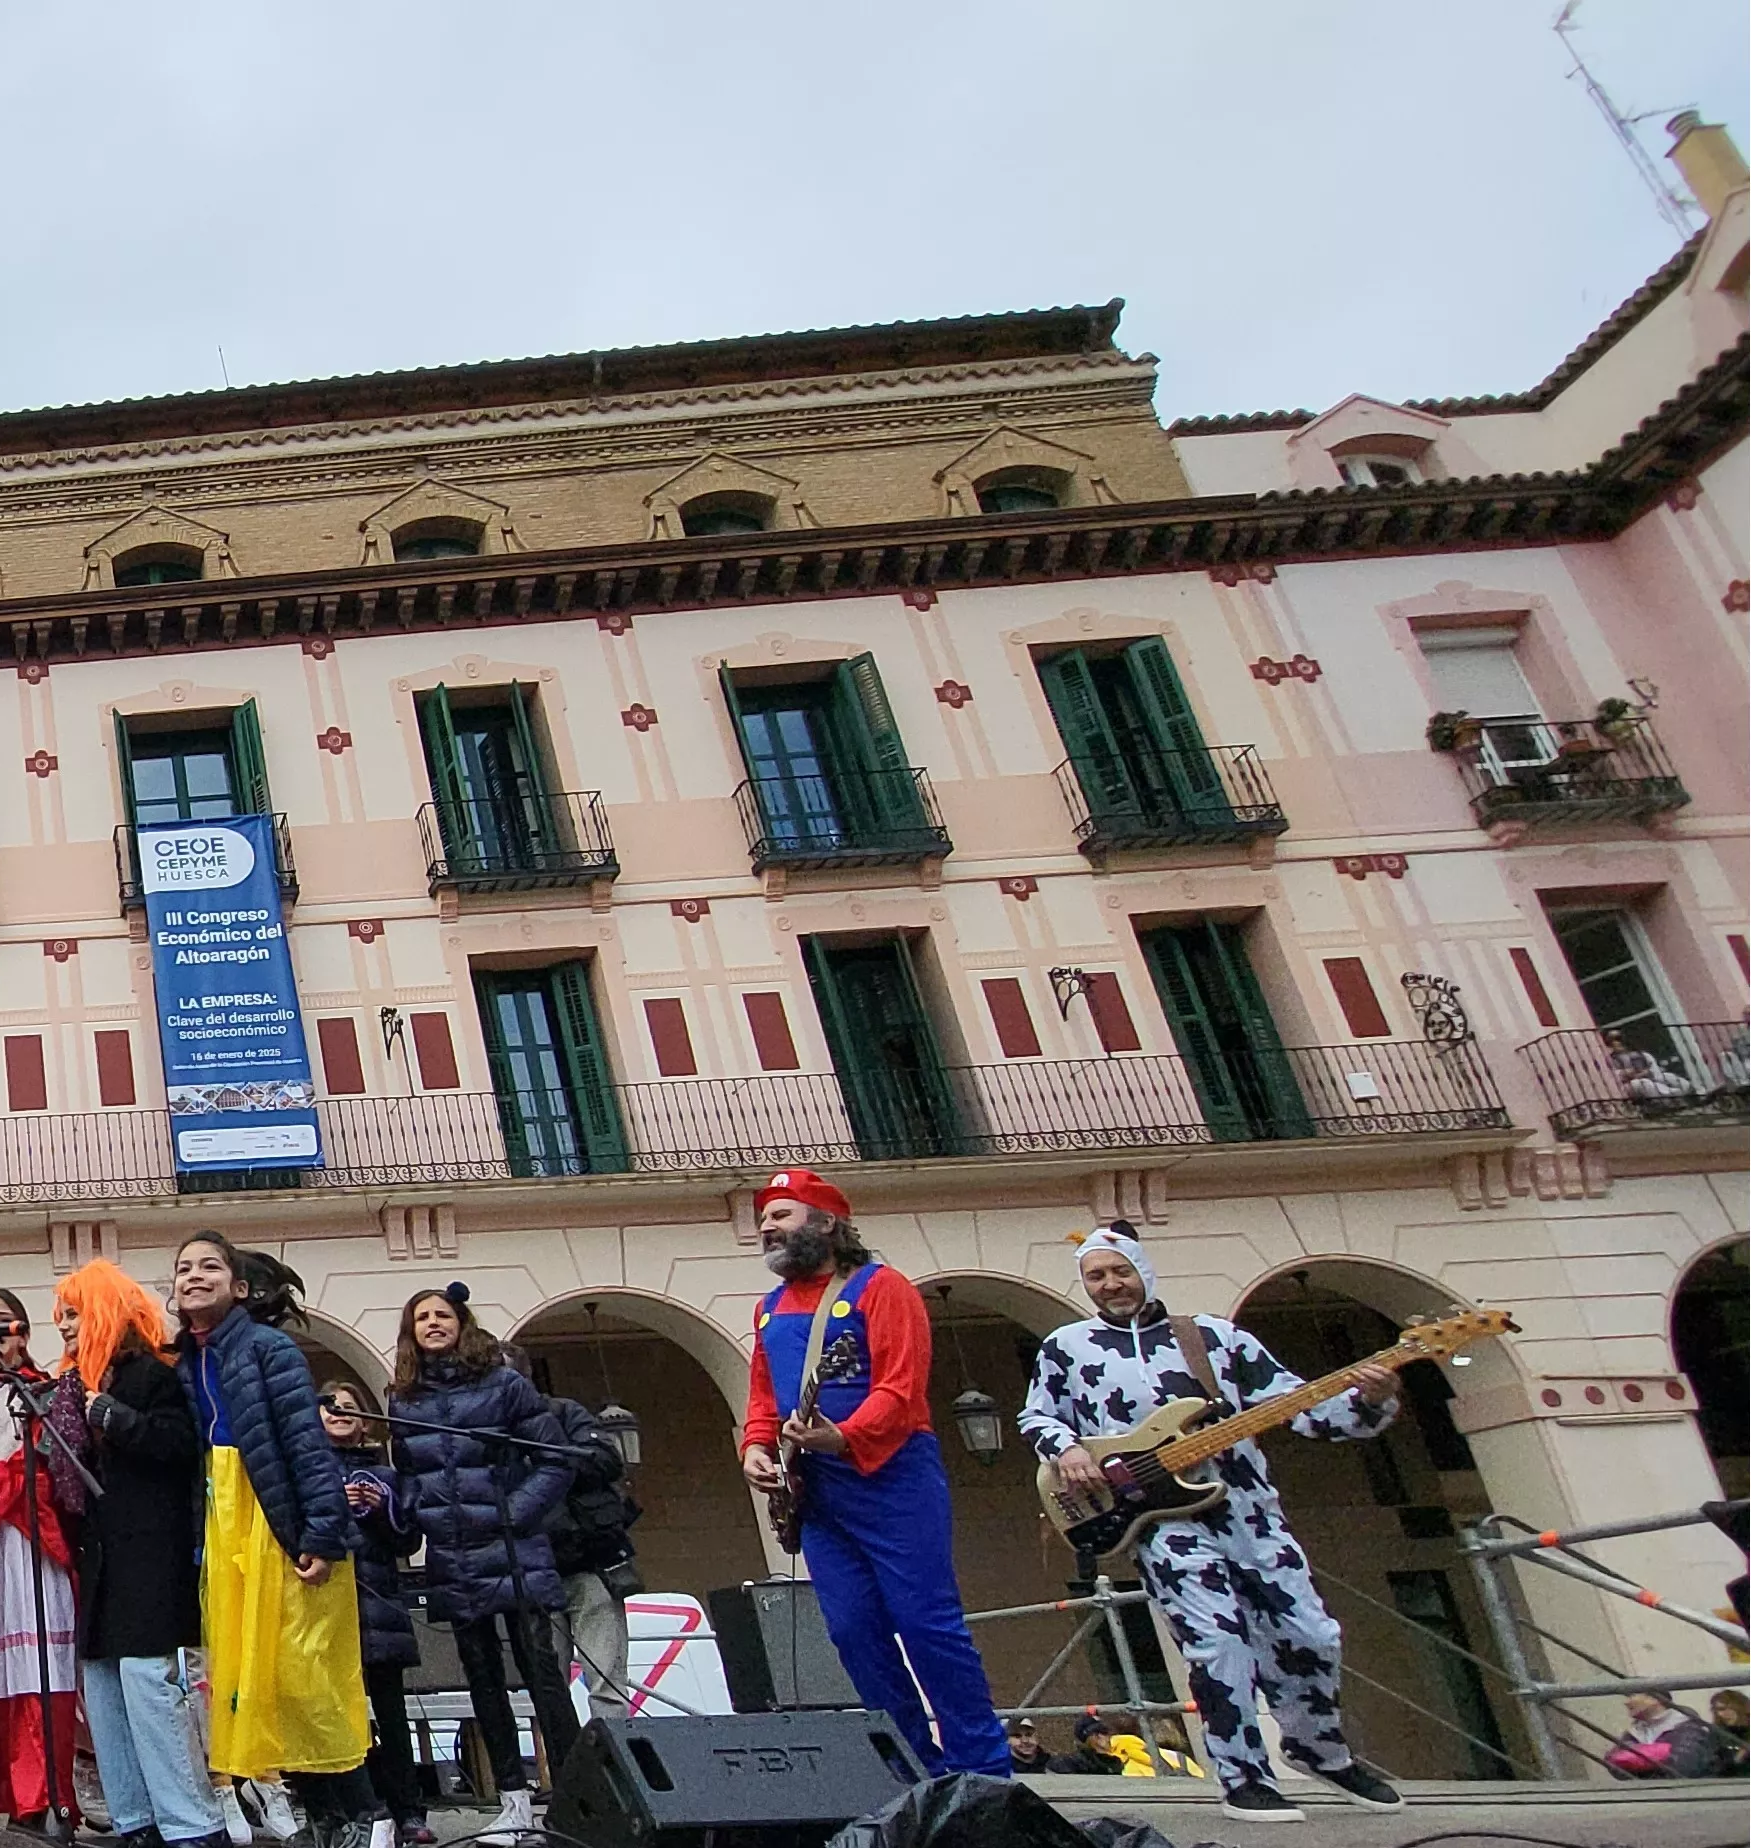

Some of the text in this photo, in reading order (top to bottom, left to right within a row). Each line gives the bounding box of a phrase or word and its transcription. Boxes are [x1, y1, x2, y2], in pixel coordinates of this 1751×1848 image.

[154, 837, 226, 857] CEOE
[156, 855, 228, 870] CEPYME
[157, 868, 229, 882] HUESCA
[165, 909, 269, 926] III Congreso
[157, 922, 283, 946] Económico del
[175, 946, 270, 965] Altoaragón
[179, 993, 278, 1010] LA EMPRESA:
[167, 1008, 295, 1027] Clave del desarrollo
[178, 1023, 287, 1040] socioeconómico
[204, 1051, 216, 1060] de
[217, 1051, 244, 1059] enero
[244, 1049, 256, 1058] de
[257, 1048, 281, 1058] 2025
[712, 1746, 823, 1774] FBT
